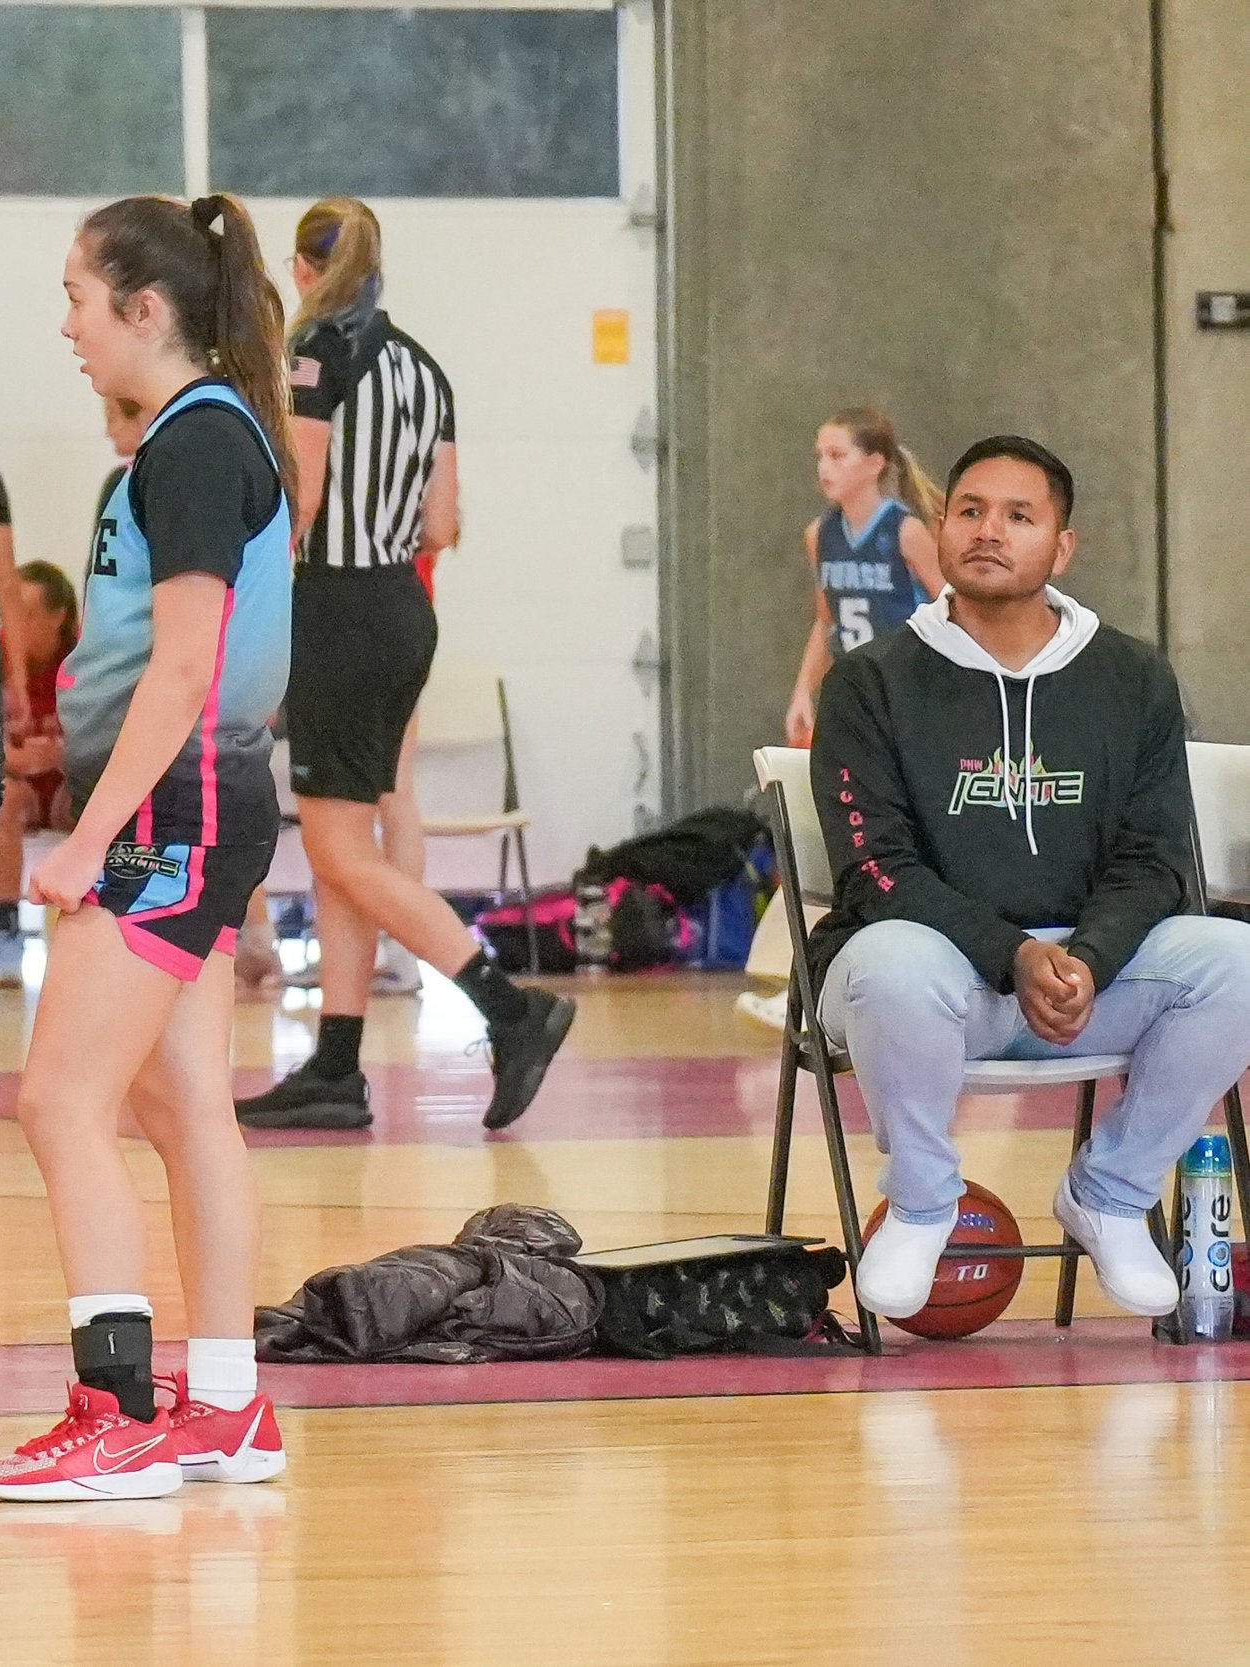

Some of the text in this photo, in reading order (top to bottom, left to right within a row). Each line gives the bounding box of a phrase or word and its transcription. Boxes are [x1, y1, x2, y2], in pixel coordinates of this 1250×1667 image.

[838, 597, 875, 653] 5
[947, 771, 1085, 815] IGNTE
[1207, 1193, 1231, 1293] core
